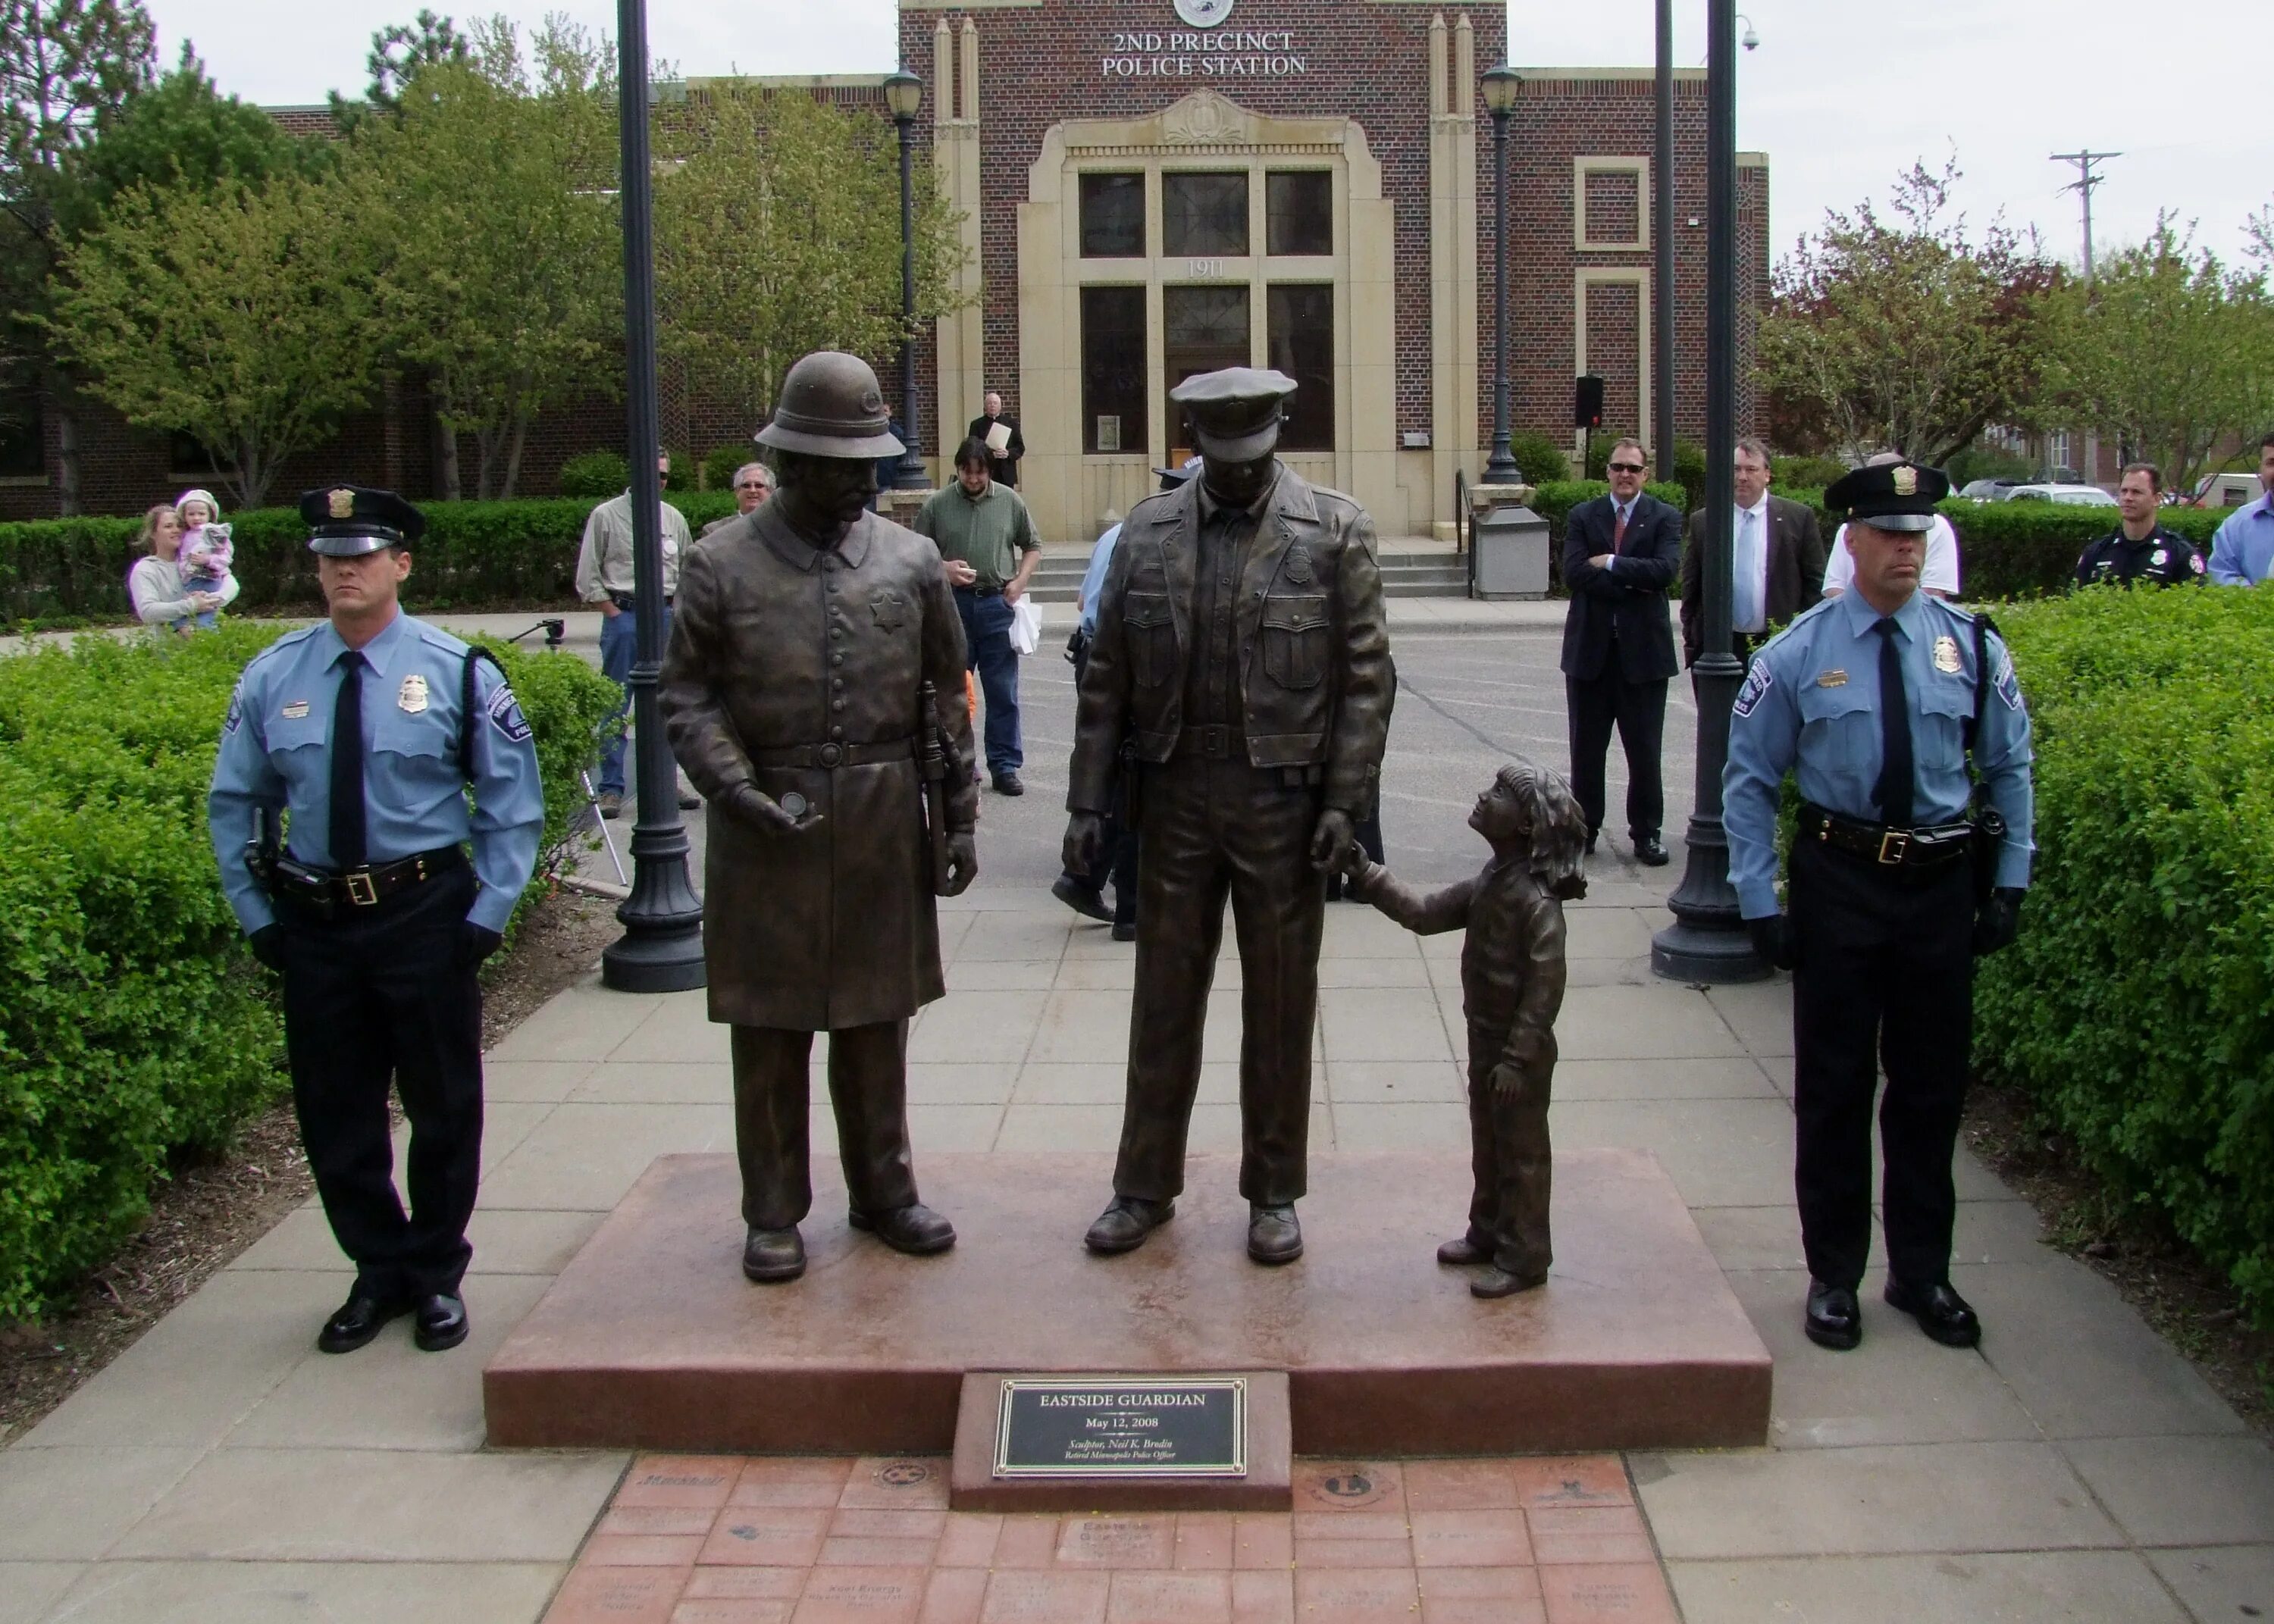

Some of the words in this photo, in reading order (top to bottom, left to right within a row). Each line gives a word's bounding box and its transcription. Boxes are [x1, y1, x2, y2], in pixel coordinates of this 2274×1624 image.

[1114, 33, 1162, 52] 2ND
[1171, 33, 1294, 52] PRECINCT
[1102, 57, 1192, 76] POLICE
[1201, 56, 1305, 75] STATION
[1189, 260, 1223, 278] 1911
[1040, 1394, 1114, 1407] EASTSIDE
[1118, 1394, 1206, 1406] GUARDIAN
[1085, 1417, 1109, 1429] May
[1113, 1418, 1128, 1428] 12,
[1132, 1417, 1159, 1427] 2008
[1069, 1439, 1105, 1451] Sculptor,
[1109, 1439, 1128, 1449] Neil
[1130, 1439, 1140, 1448] K.
[1143, 1439, 1173, 1448] Brodin
[1065, 1450, 1089, 1460] Retired
[1091, 1450, 1131, 1460] Minneapolis
[1133, 1450, 1151, 1459] Police
[1153, 1450, 1176, 1460] Officer
